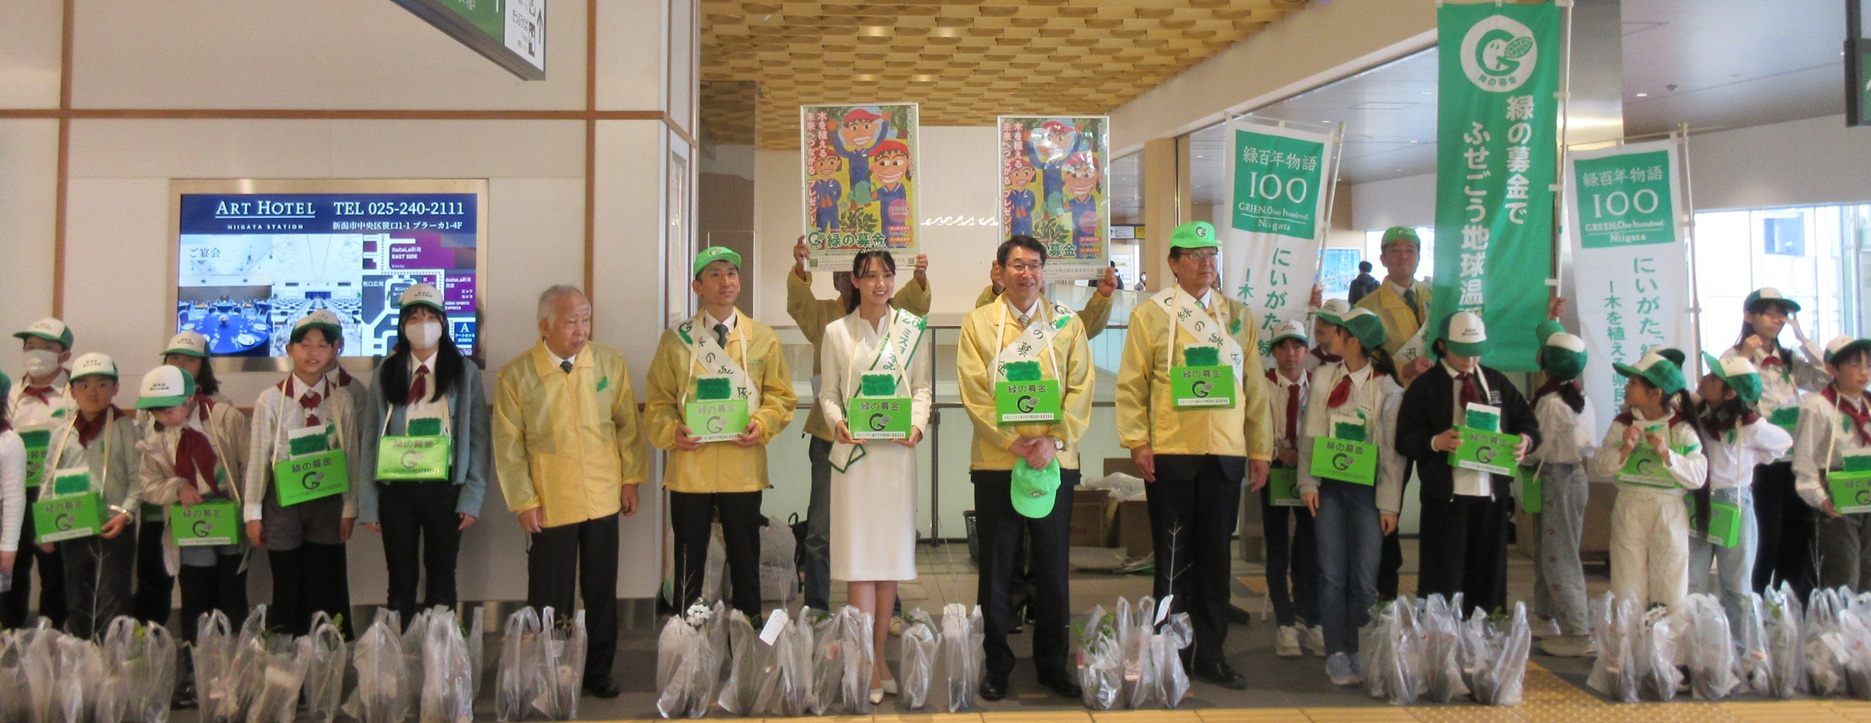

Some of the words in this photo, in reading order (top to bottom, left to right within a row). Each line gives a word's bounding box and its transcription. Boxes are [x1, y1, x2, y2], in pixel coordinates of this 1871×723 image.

[1243, 146, 1317, 172] 緑百年物語
[1505, 95, 1535, 225] 緑の募金で
[257, 200, 316, 215] HOTEL
[333, 202, 365, 215] TEL
[368, 202, 465, 215] 025-240-2111
[808, 180, 817, 225] プレゼント
[1003, 190, 1013, 235] プレゼント
[461, 322, 470, 333] A
[1183, 369, 1221, 378] 緑の募金
[1007, 384, 1046, 394] 緑の募金
[861, 402, 899, 411] 緑の募金
[291, 457, 332, 473] 緑の募金
